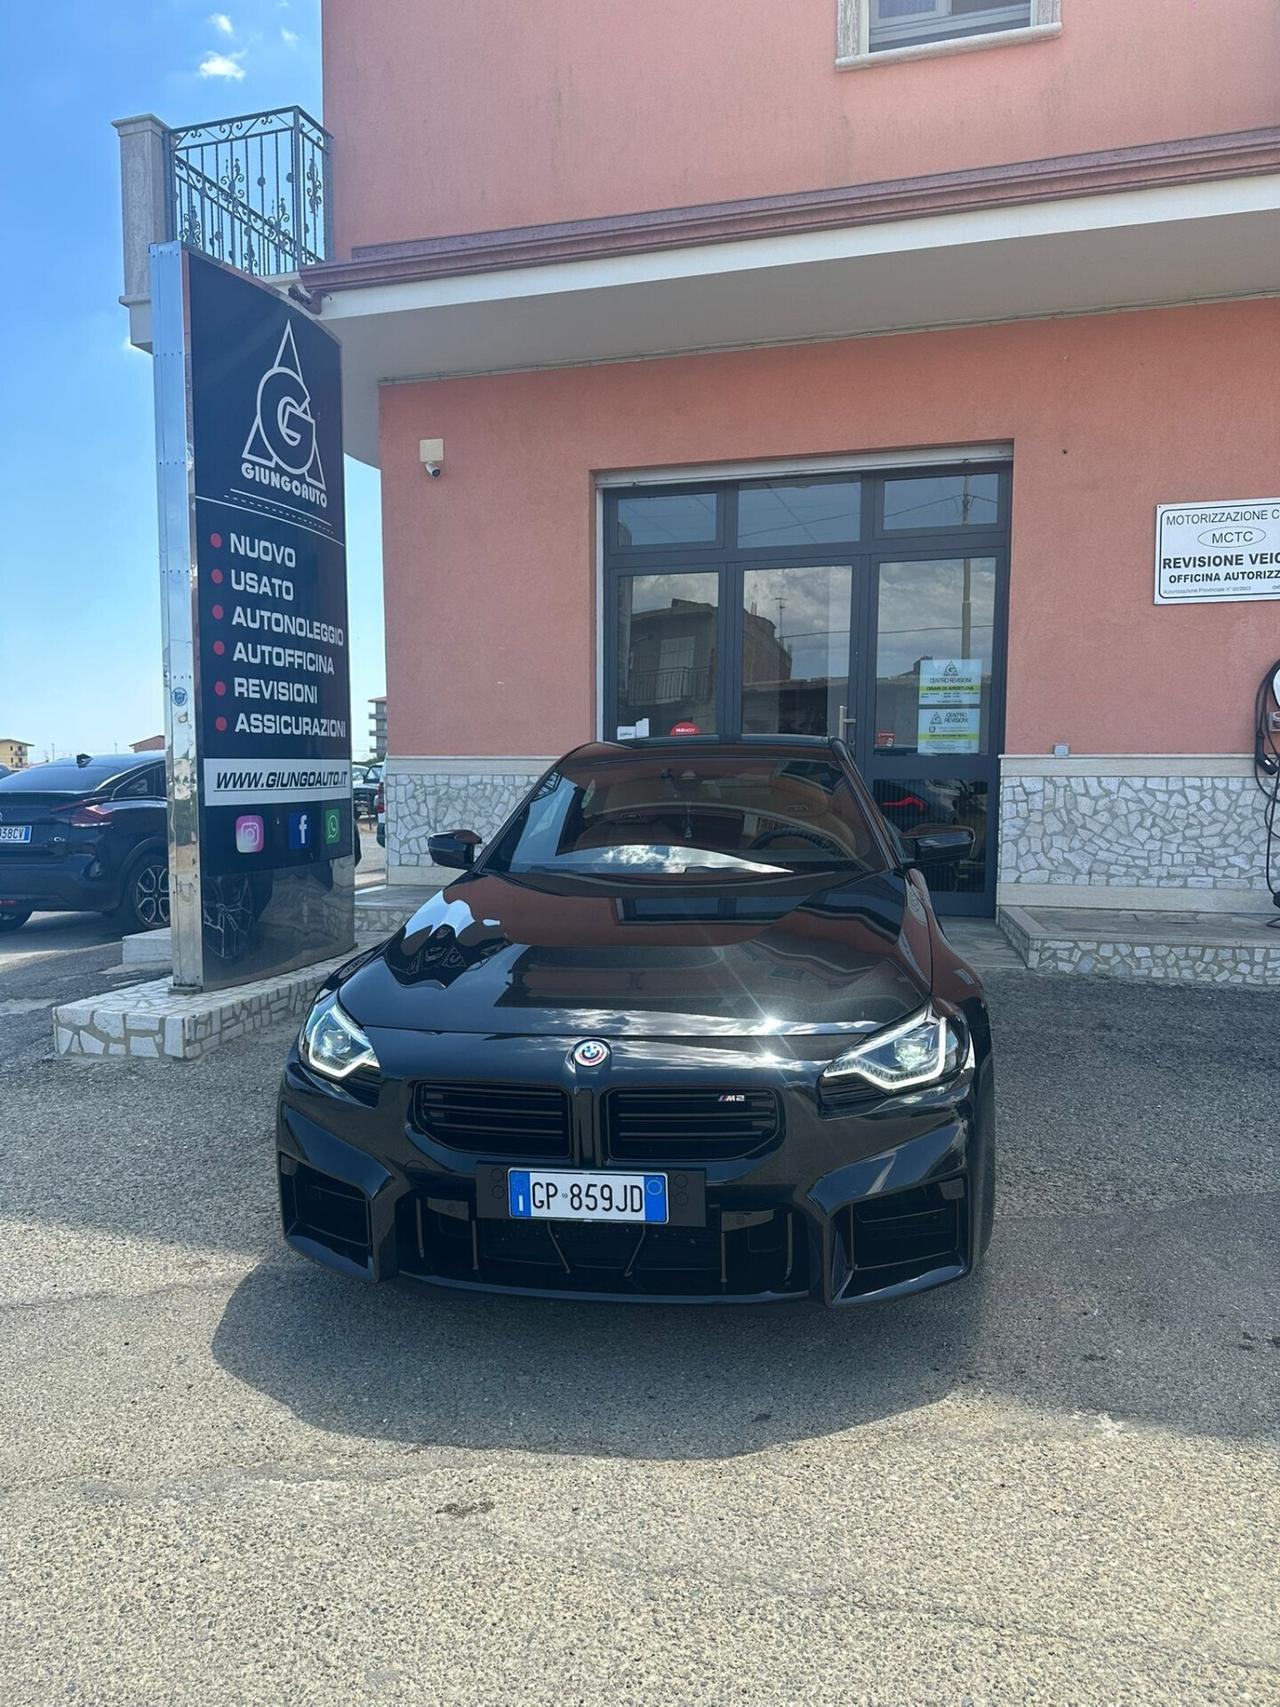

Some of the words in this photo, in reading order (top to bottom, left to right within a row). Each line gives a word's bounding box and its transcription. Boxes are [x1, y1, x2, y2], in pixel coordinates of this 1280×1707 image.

[241, 462, 328, 508] GIUNGOAUTO
[1166, 509, 1268, 526] MOTORIZZAZIONE
[230, 533, 296, 567] NUOVO
[1211, 530, 1254, 544] MCTC
[1162, 553, 1244, 570] REVISIONE
[231, 568, 294, 601] USATO
[1168, 572, 1221, 584] OFFICINA
[232, 606, 344, 648] AUTONOLEGGIO
[232, 642, 335, 676] AUTOFFICINA
[234, 677, 318, 704] REVISIONI
[235, 712, 346, 739] ASSICURAZIONI
[216, 771, 348, 789] WWW.GIUNGOAUTO.IT
[531, 1181, 559, 1210] GP
[569, 1183, 644, 1213] 859JD
